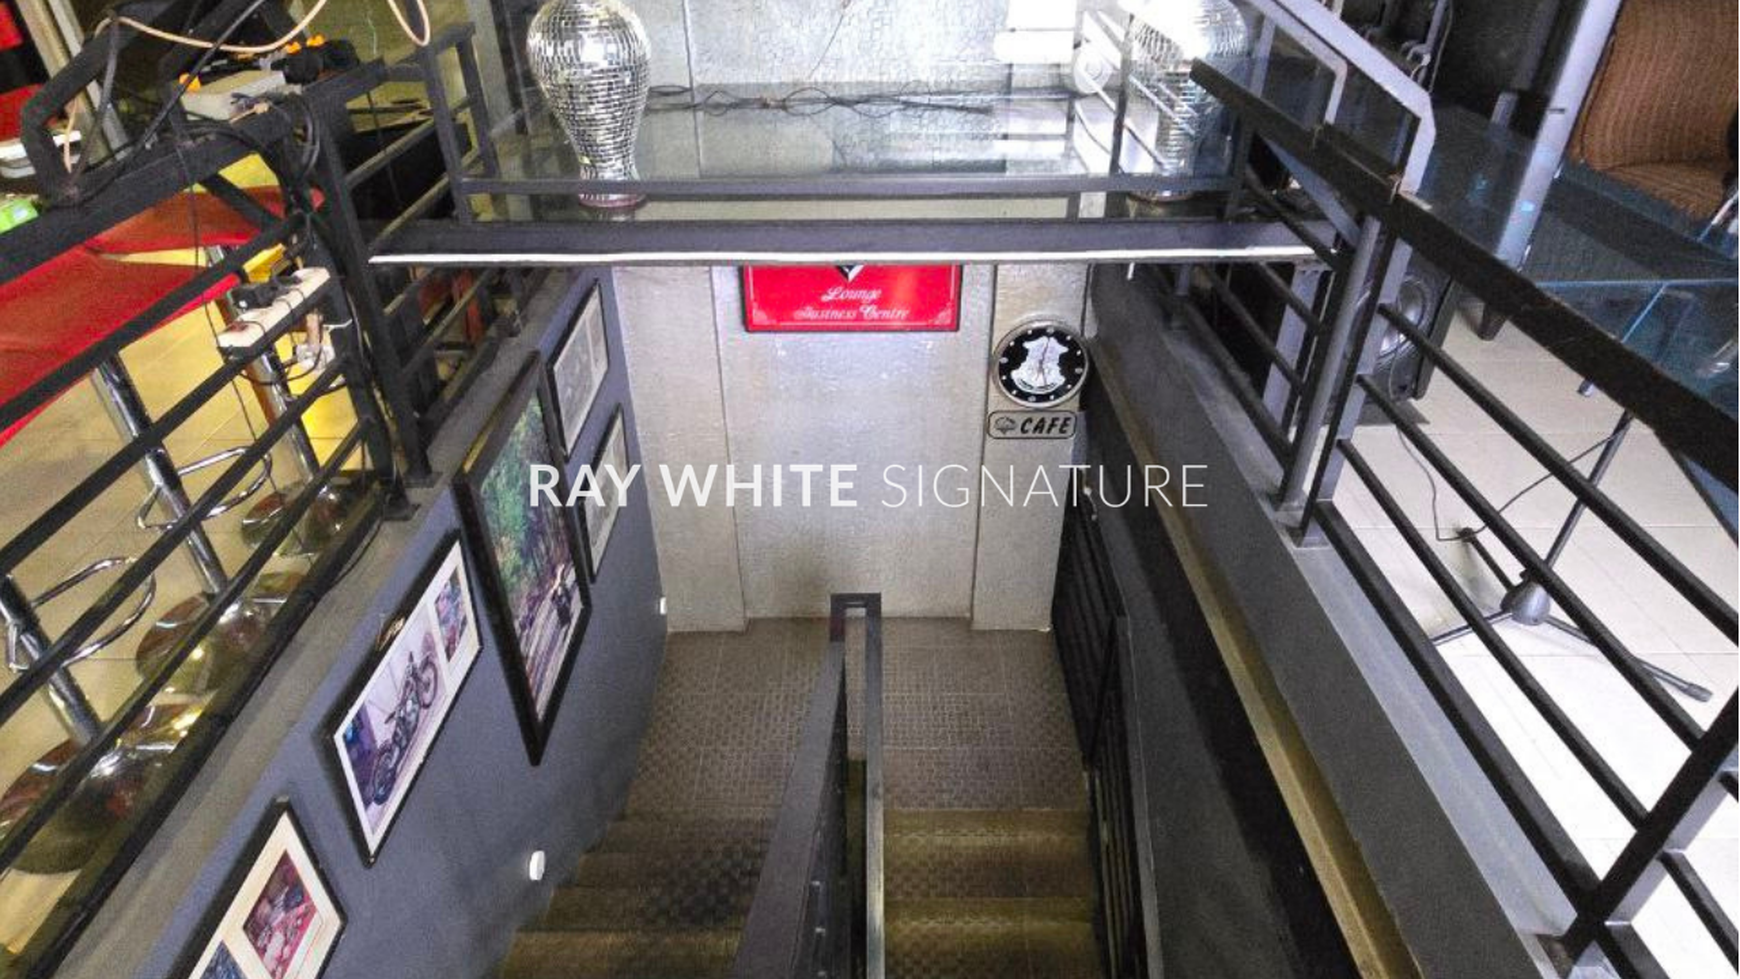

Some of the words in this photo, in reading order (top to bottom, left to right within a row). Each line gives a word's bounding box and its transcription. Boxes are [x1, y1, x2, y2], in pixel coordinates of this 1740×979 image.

[821, 286, 882, 304] Lounge
[793, 306, 857, 320] Business
[859, 304, 910, 320] Centre
[1020, 417, 1072, 434] CAFE
